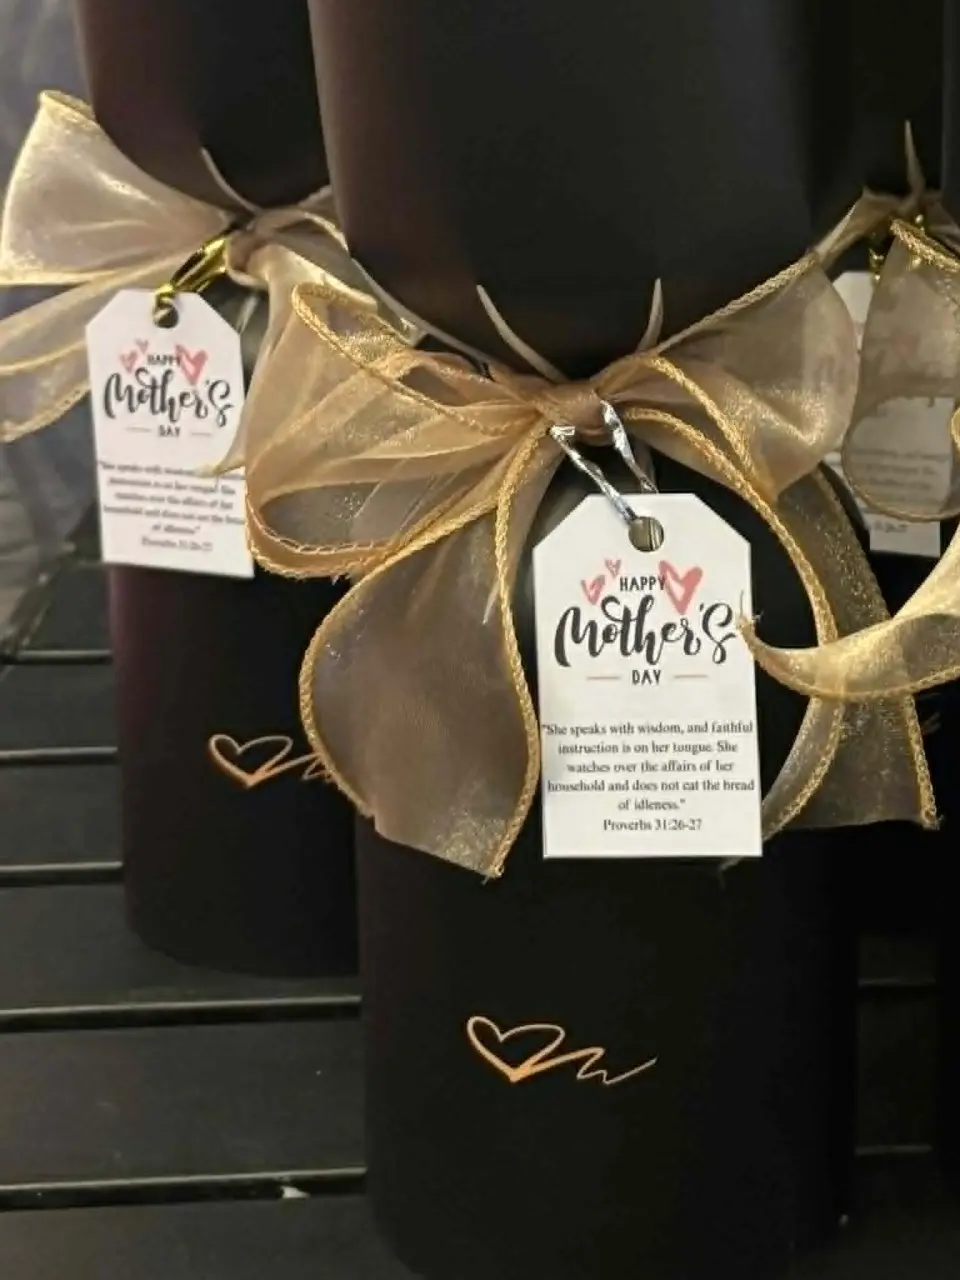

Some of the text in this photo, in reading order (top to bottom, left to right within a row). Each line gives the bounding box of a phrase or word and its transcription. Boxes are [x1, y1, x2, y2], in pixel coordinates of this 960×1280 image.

[619, 575, 666, 592] HAPPY
[631, 669, 662, 686] DAY
[570, 722, 607, 738] speaks
[609, 722, 634, 734] with
[637, 721, 684, 735] wisdom,
[687, 721, 708, 733] and
[712, 720, 753, 733] faithful
[558, 741, 618, 754] instruction
[622, 740, 631, 753] is
[634, 744, 649, 753] on
[652, 739, 670, 753] her
[717, 739, 738, 753] She
[566, 759, 734, 772] watches over the affairs of her
[547, 780, 755, 793] household and does not eat the bread
[618, 798, 631, 811] of
[603, 818, 702, 831] Proverbs 31:26-27
